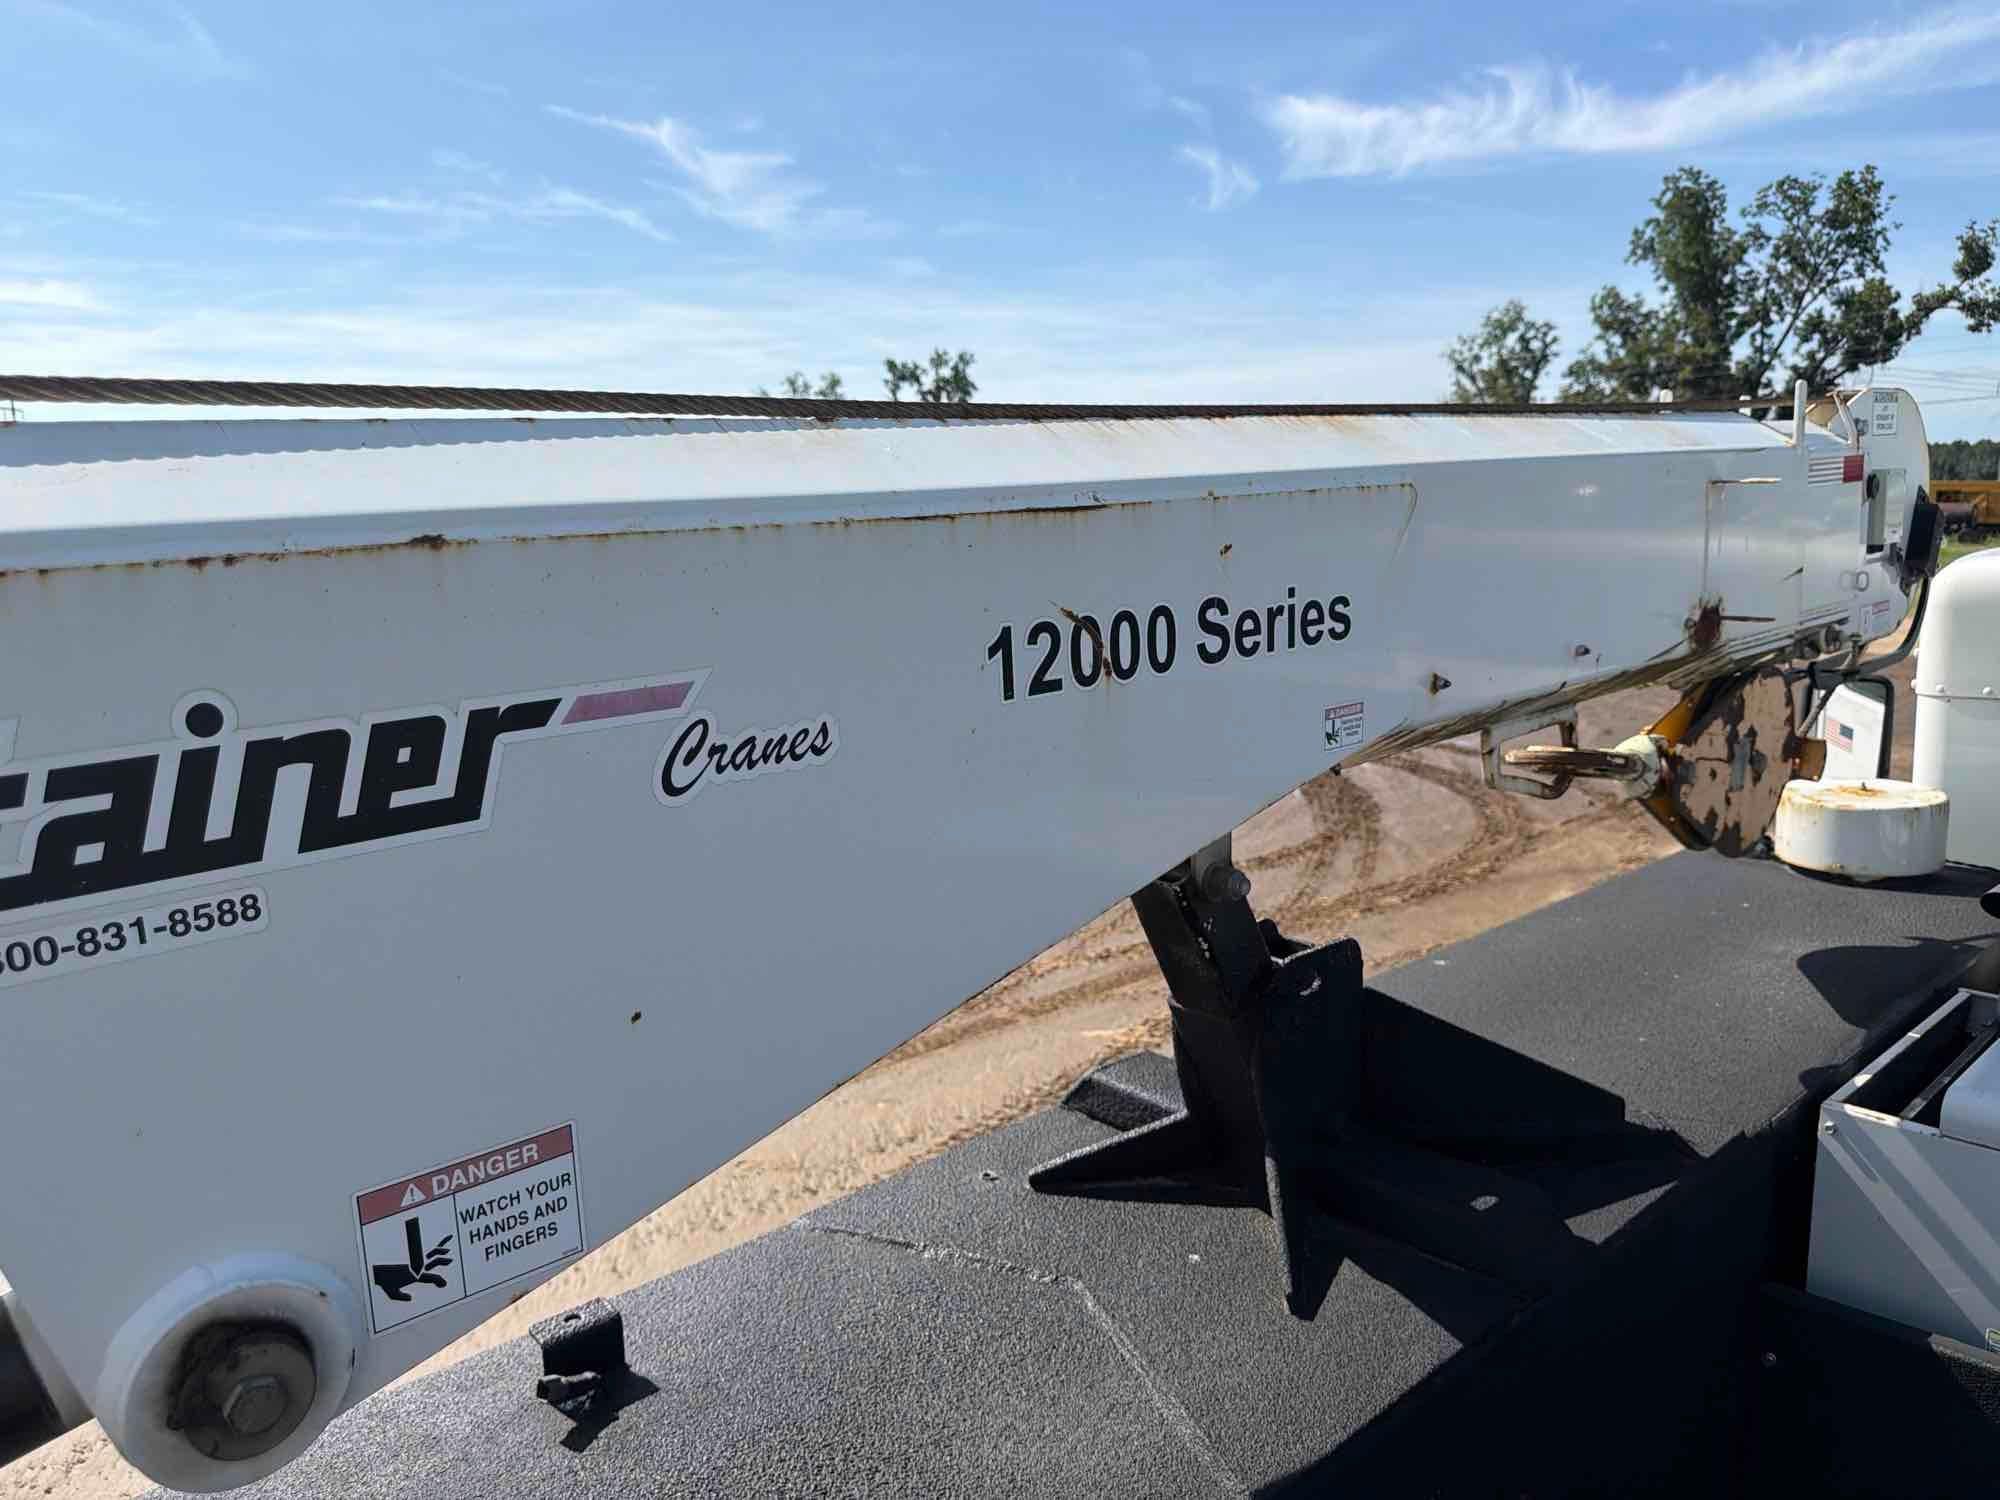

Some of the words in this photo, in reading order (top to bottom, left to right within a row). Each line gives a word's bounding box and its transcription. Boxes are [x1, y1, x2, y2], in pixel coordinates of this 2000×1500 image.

[986, 604, 1177, 702] 12000
[1197, 586, 1352, 665] Series
[661, 718, 832, 797] Cranes
[0, 894, 262, 975] 00-831-8588
[431, 1143, 539, 1196] DANGER
[459, 1190, 521, 1225] WATCH
[525, 1172, 572, 1201] YOUR
[469, 1210, 530, 1245] HANDS
[533, 1195, 568, 1221] AND
[484, 1222, 559, 1262] FINGERS
